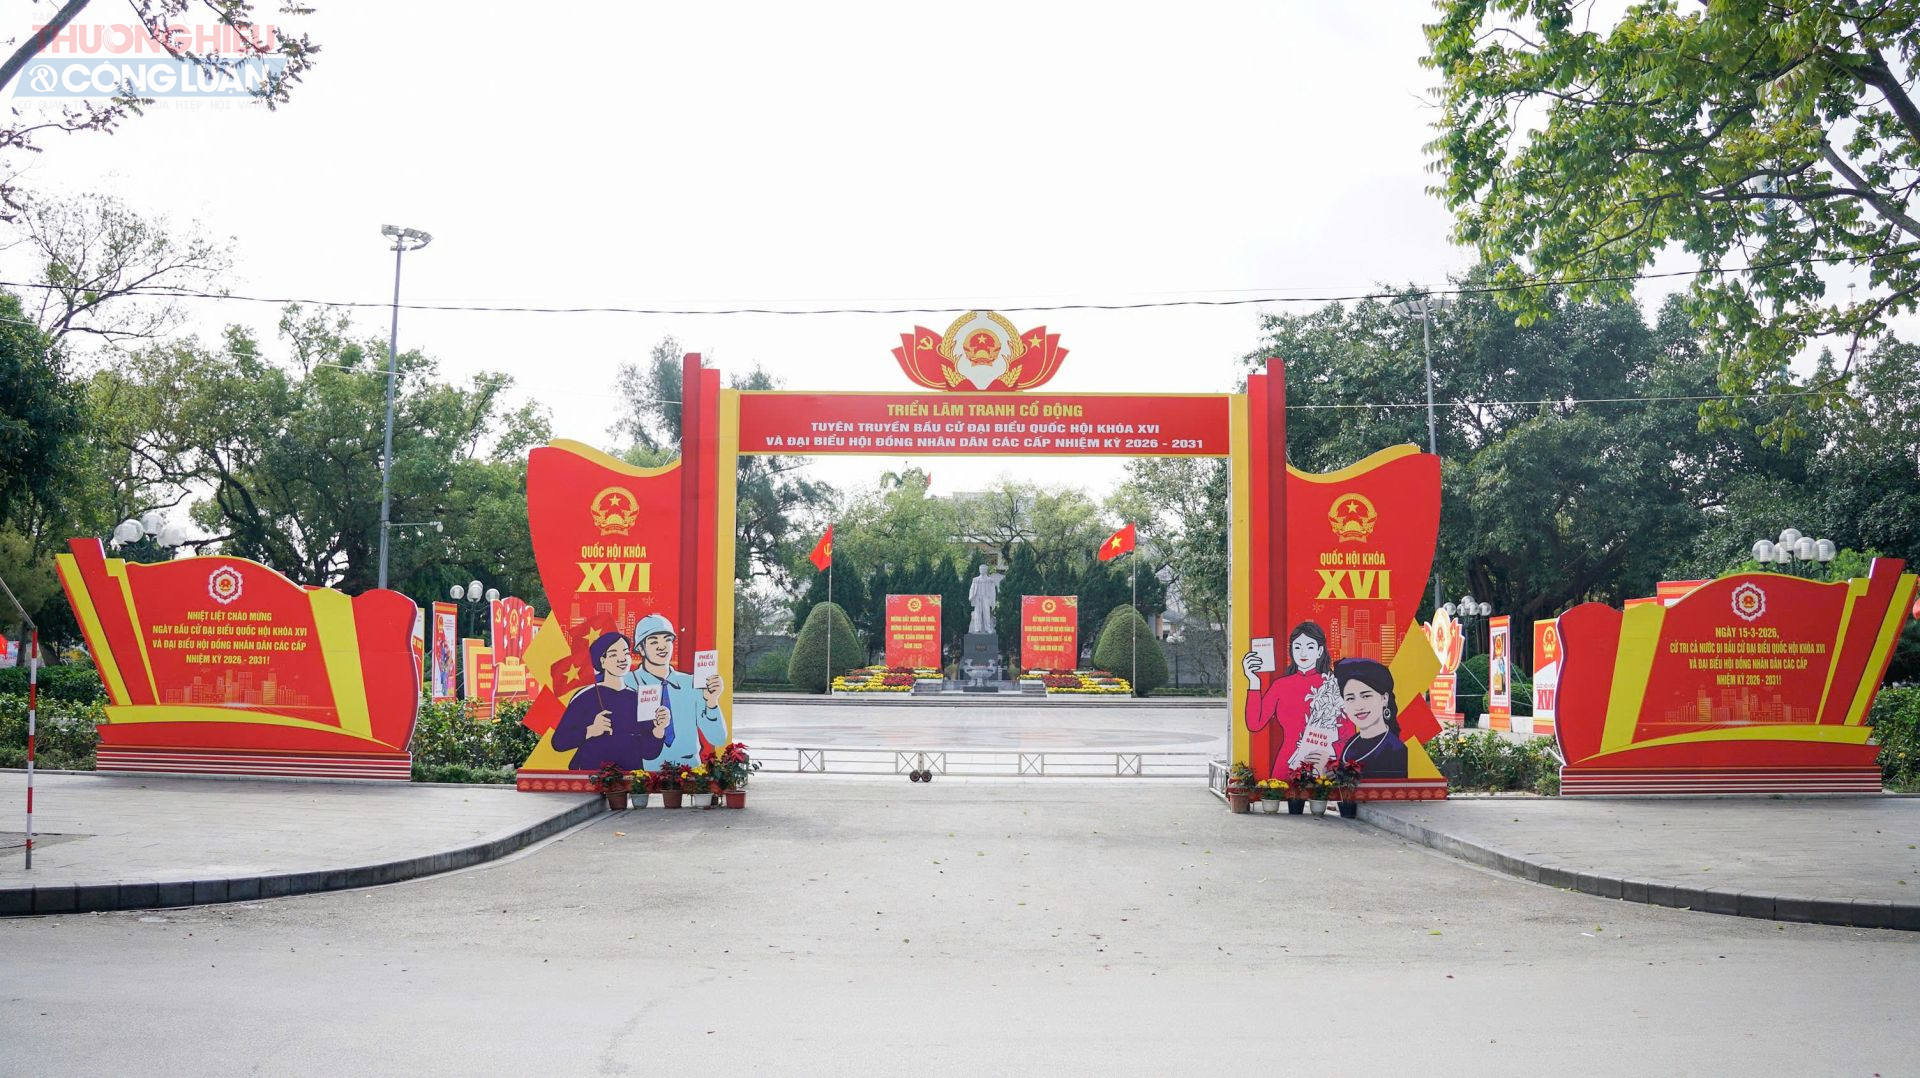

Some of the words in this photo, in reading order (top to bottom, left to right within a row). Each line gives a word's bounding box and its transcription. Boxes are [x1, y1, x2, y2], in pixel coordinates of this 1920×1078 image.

[887, 399, 928, 417] TRIỂN
[968, 404, 1015, 417] TRANH
[1020, 400, 1039, 417] CỔ
[1043, 403, 1083, 419] ĐỘNG
[811, 421, 854, 432] TUYÊN
[857, 419, 909, 432] TRUYỀN
[914, 420, 941, 432] BẦU
[945, 421, 965, 433] CỬ
[967, 424, 990, 434] ĐẠI
[994, 420, 1025, 433] BIỂU
[1030, 421, 1066, 434] QUỐC
[1070, 422, 1093, 435] HỘI
[1097, 422, 1133, 434] KHÓA
[1138, 424, 1160, 434] XVI
[766, 435, 783, 446] VÀ
[787, 437, 810, 448] ĐẠI
[814, 434, 844, 446] BIỂU
[849, 436, 872, 448] HỘI
[876, 435, 913, 447] ĐỒNG
[917, 435, 956, 447] NHÂN
[960, 436, 988, 447] DÂN
[992, 436, 1019, 447] CÁC
[1023, 435, 1051, 448] CẤP
[1055, 437, 1100, 450] NHIỆM
[1125, 439, 1158, 448] 2026
[1171, 439, 1203, 449] 2031
[581, 541, 604, 560] QUỐC
[606, 543, 622, 560] HỘI
[623, 543, 647, 558] KHÓA
[1320, 548, 1343, 567] QUỐC
[1345, 550, 1360, 568] HỘI
[1362, 550, 1386, 566] KHÓA
[575, 562, 652, 593] XVI
[1314, 569, 1392, 600] XVI
[187, 610, 209, 622] NHIỆT
[210, 610, 226, 622] LIỆT
[227, 611, 247, 621] CHÀO
[249, 611, 272, 621] MỪNG
[1715, 626, 1736, 637] NGÀY
[186, 653, 210, 665] NHIỆM
[223, 655, 242, 664] 2026
